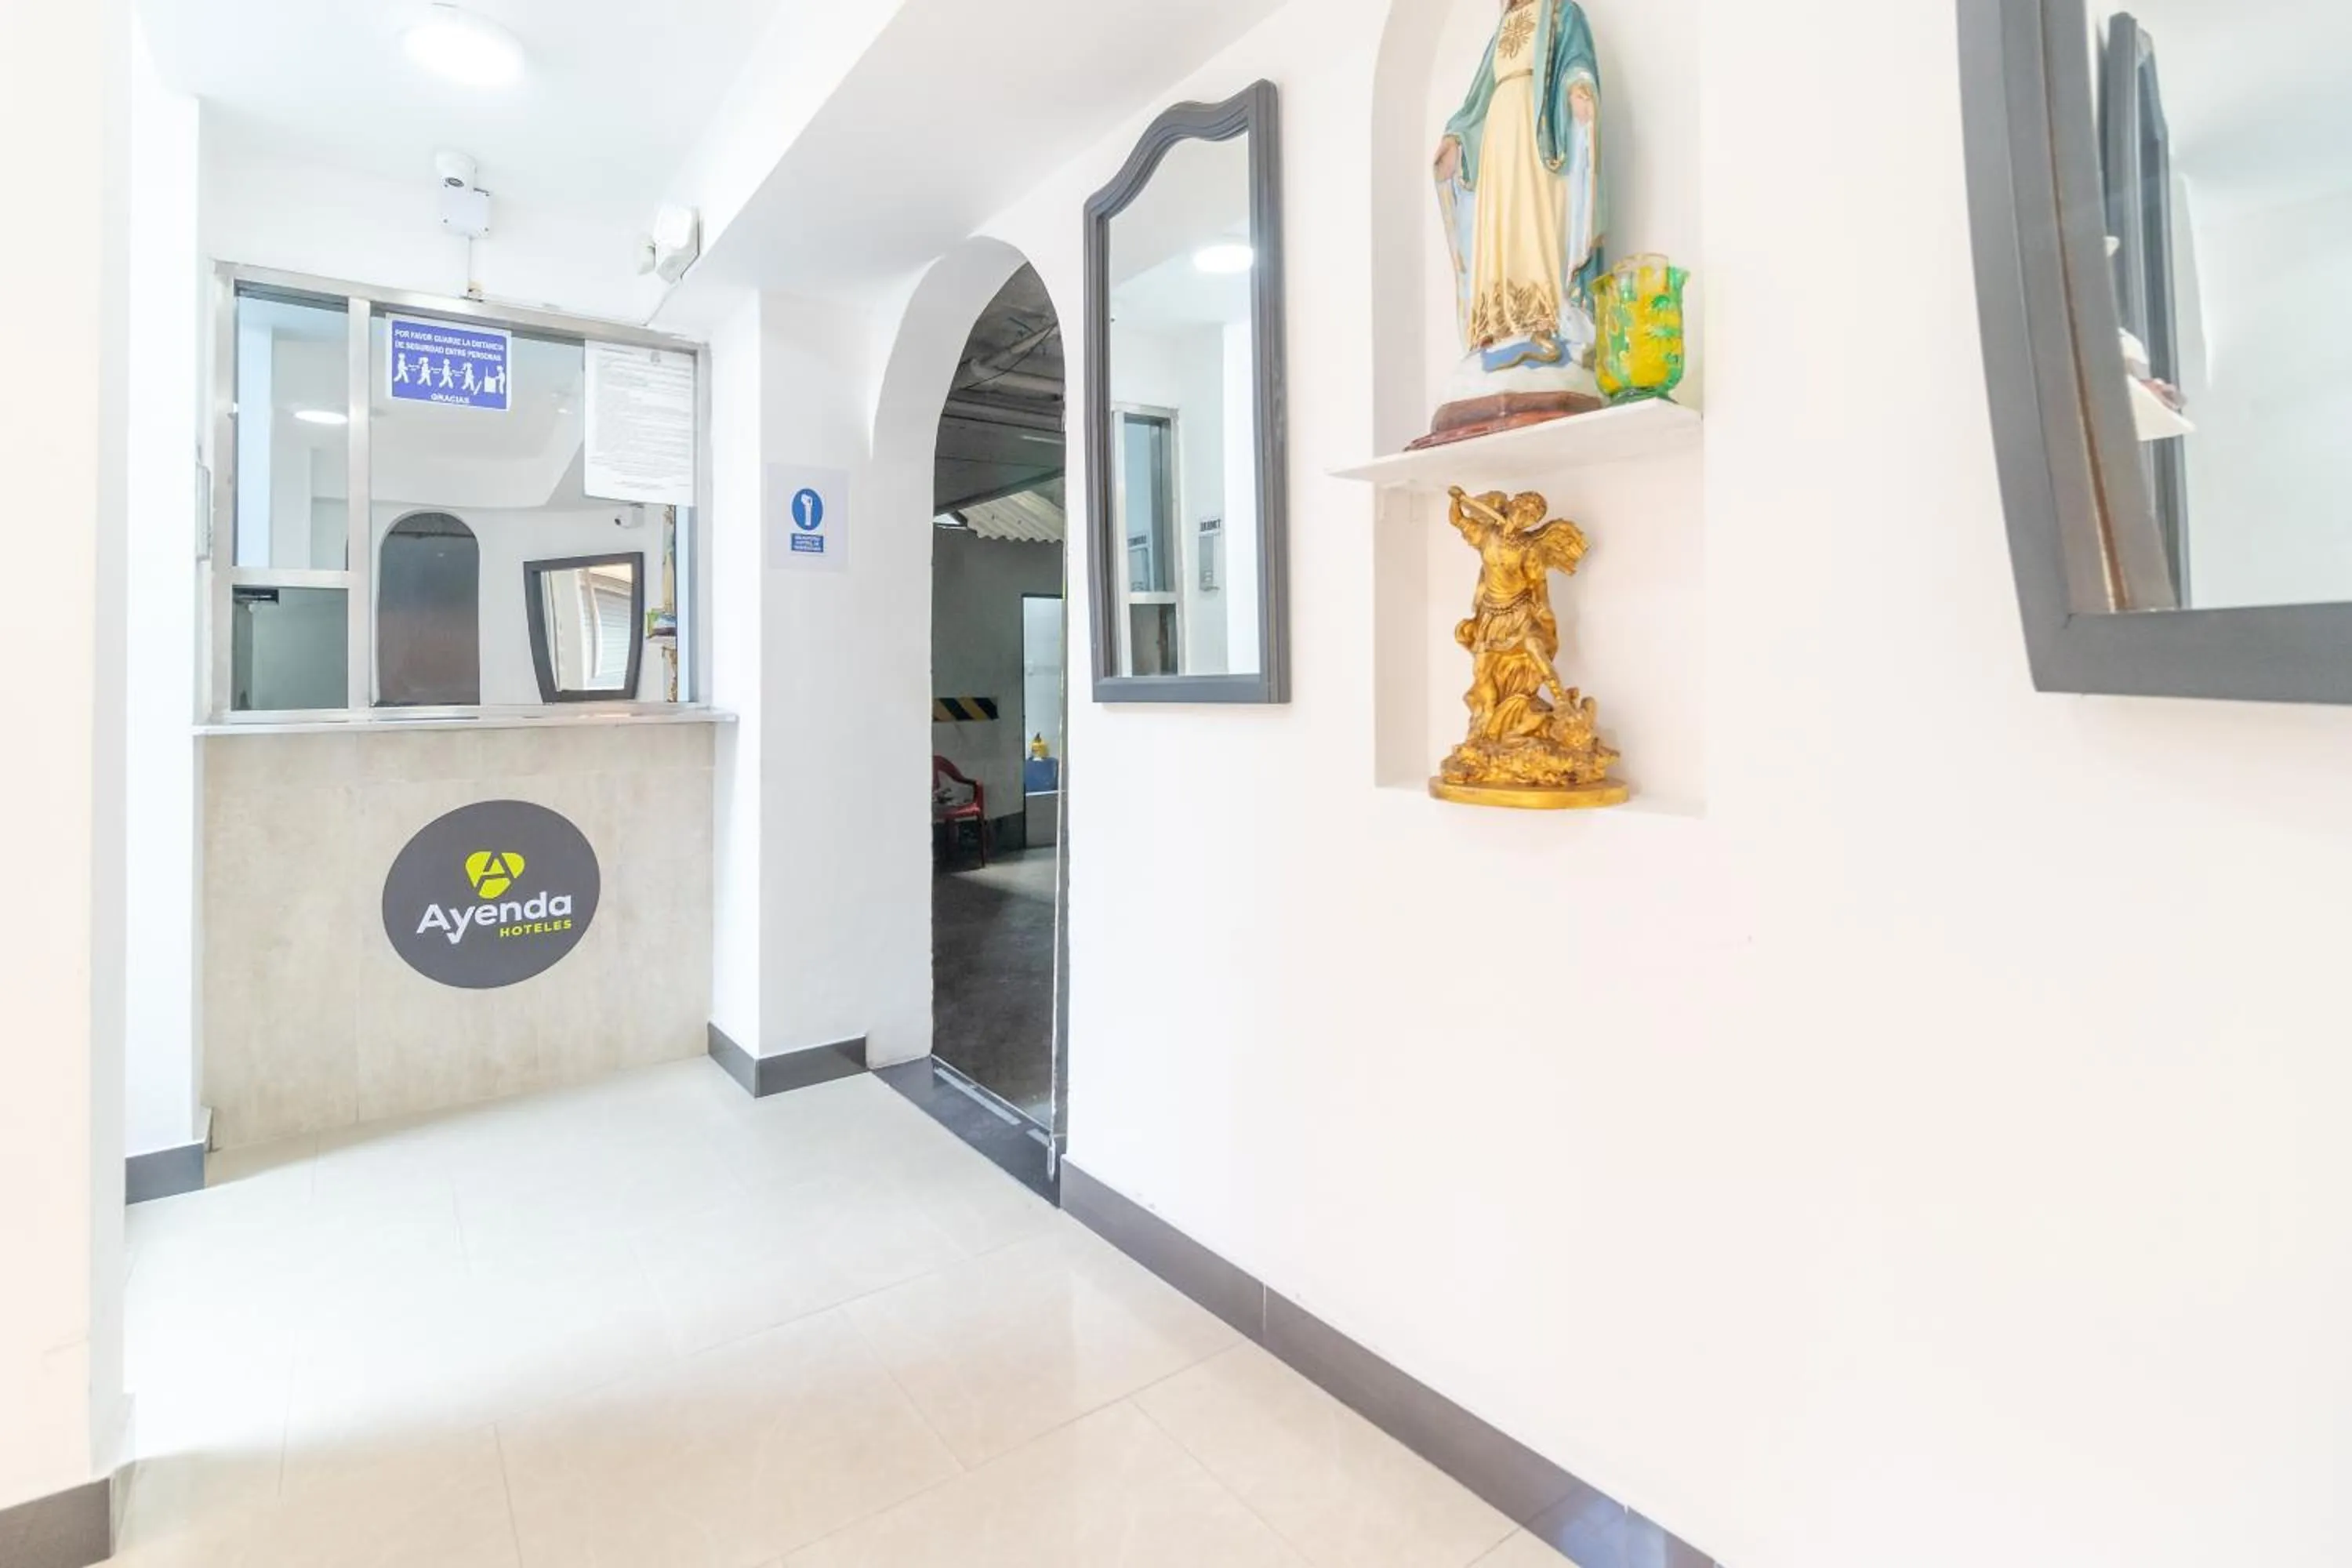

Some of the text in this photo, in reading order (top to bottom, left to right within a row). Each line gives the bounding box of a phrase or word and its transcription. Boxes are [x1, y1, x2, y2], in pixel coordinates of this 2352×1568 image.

[394, 329, 409, 338] POR
[410, 332, 432, 341] FAVOR
[462, 338, 470, 347] LA
[394, 340, 405, 349] DE
[405, 342, 445, 354] SEGURIDAD
[445, 347, 466, 358] ENTRE
[431, 393, 470, 403] GRACIAS
[416, 891, 572, 944] Ayenda
[499, 920, 572, 937] HOTELES
